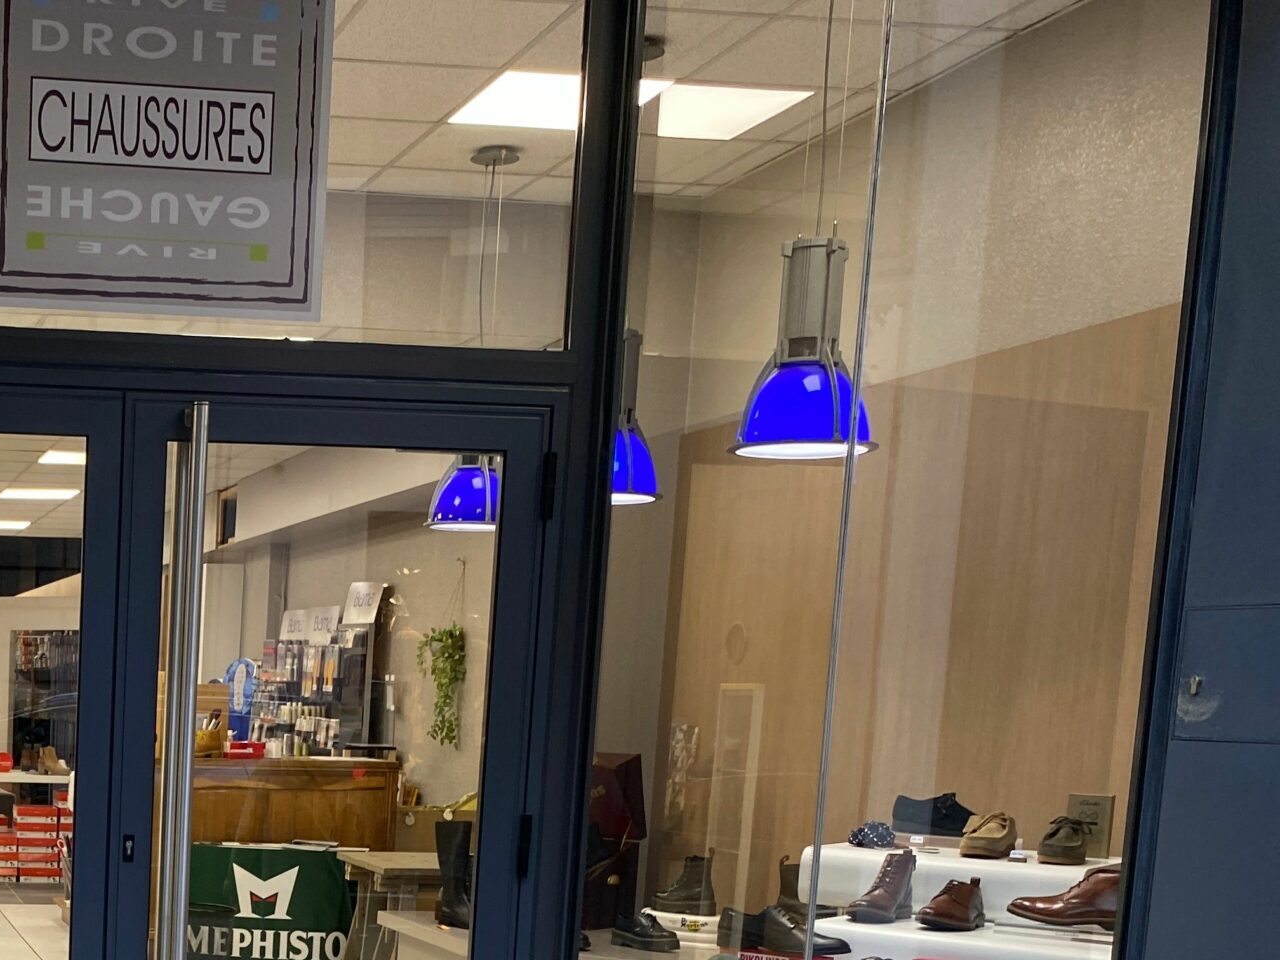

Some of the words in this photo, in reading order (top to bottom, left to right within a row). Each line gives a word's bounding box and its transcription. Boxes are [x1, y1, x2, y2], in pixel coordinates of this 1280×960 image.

[31, 18, 278, 67] DROITE
[37, 89, 266, 165] CHAUSSURES
[26, 184, 270, 230] GAUCHE
[77, 241, 217, 261] RIVE
